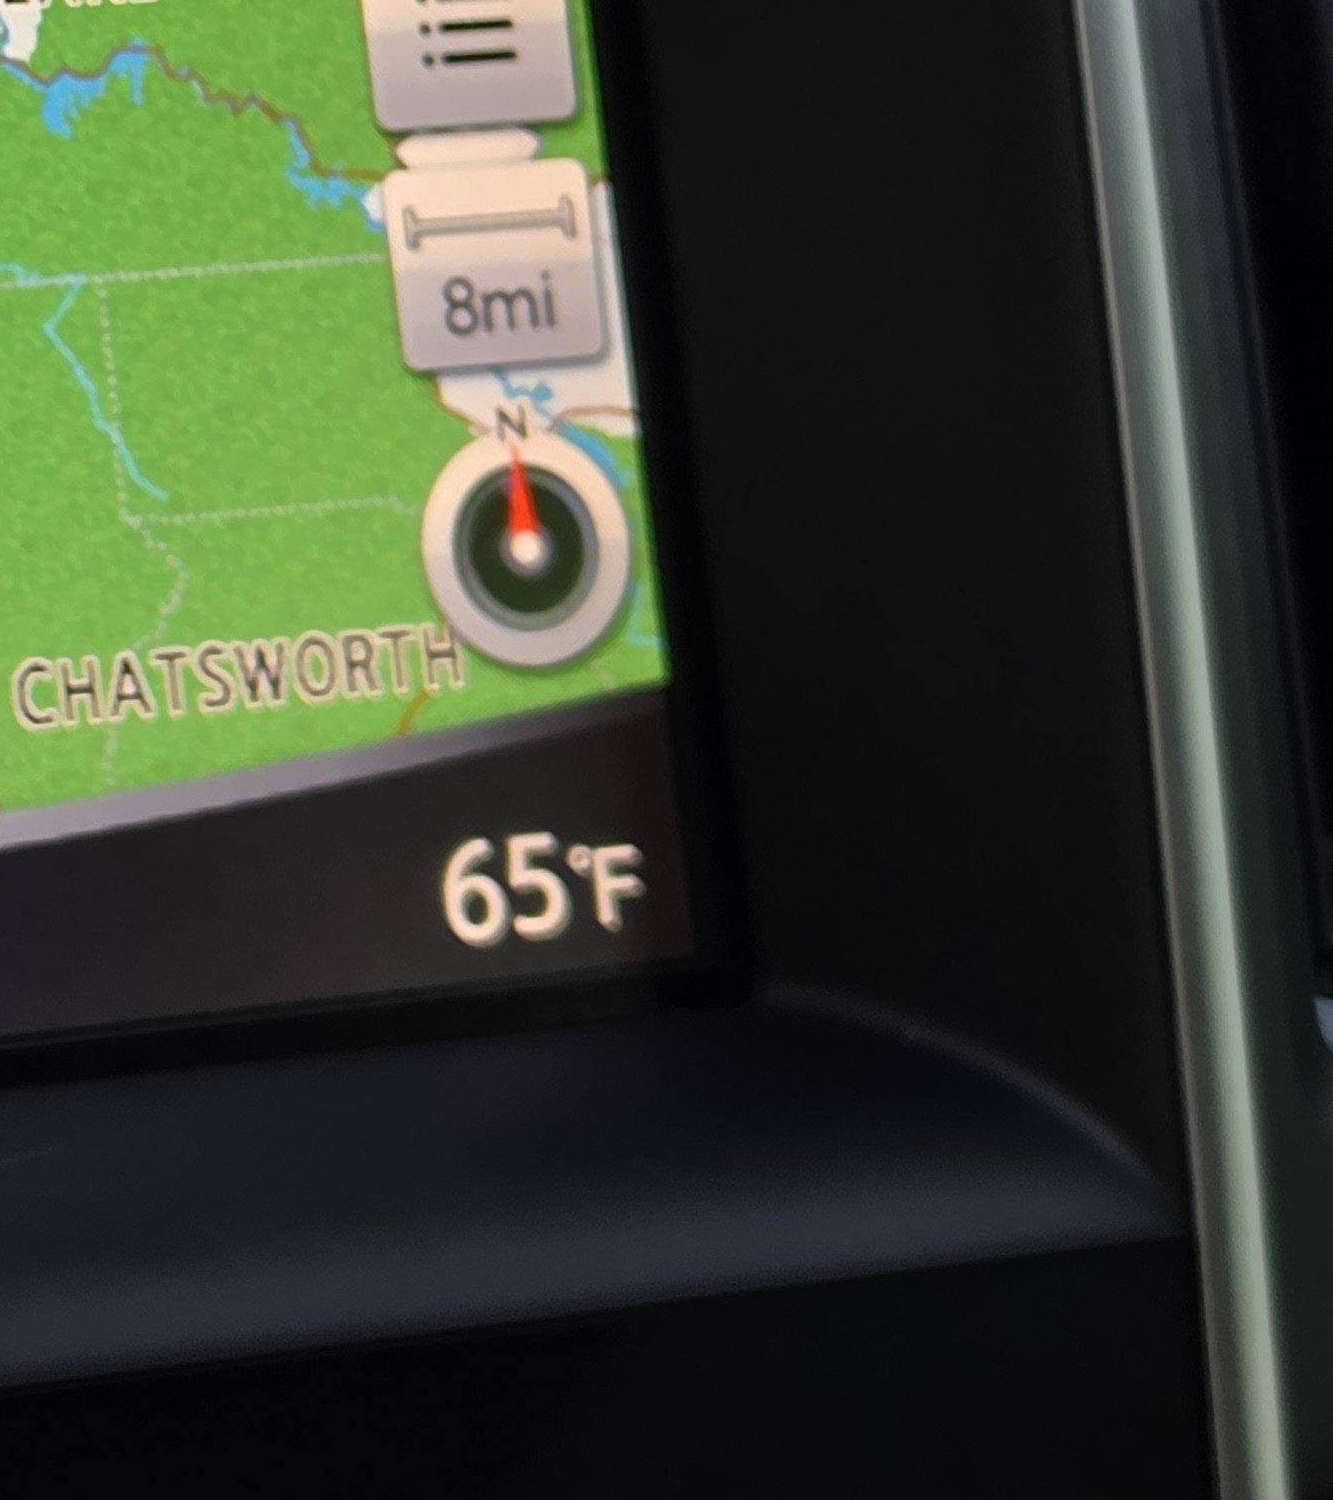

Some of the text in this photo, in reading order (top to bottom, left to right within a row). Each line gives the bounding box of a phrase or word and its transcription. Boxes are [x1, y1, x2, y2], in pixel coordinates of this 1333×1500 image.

[442, 272, 557, 336] 8mi
[497, 405, 528, 443] N
[15, 628, 465, 726] CHATSWORTH
[443, 832, 645, 948] 65°F
